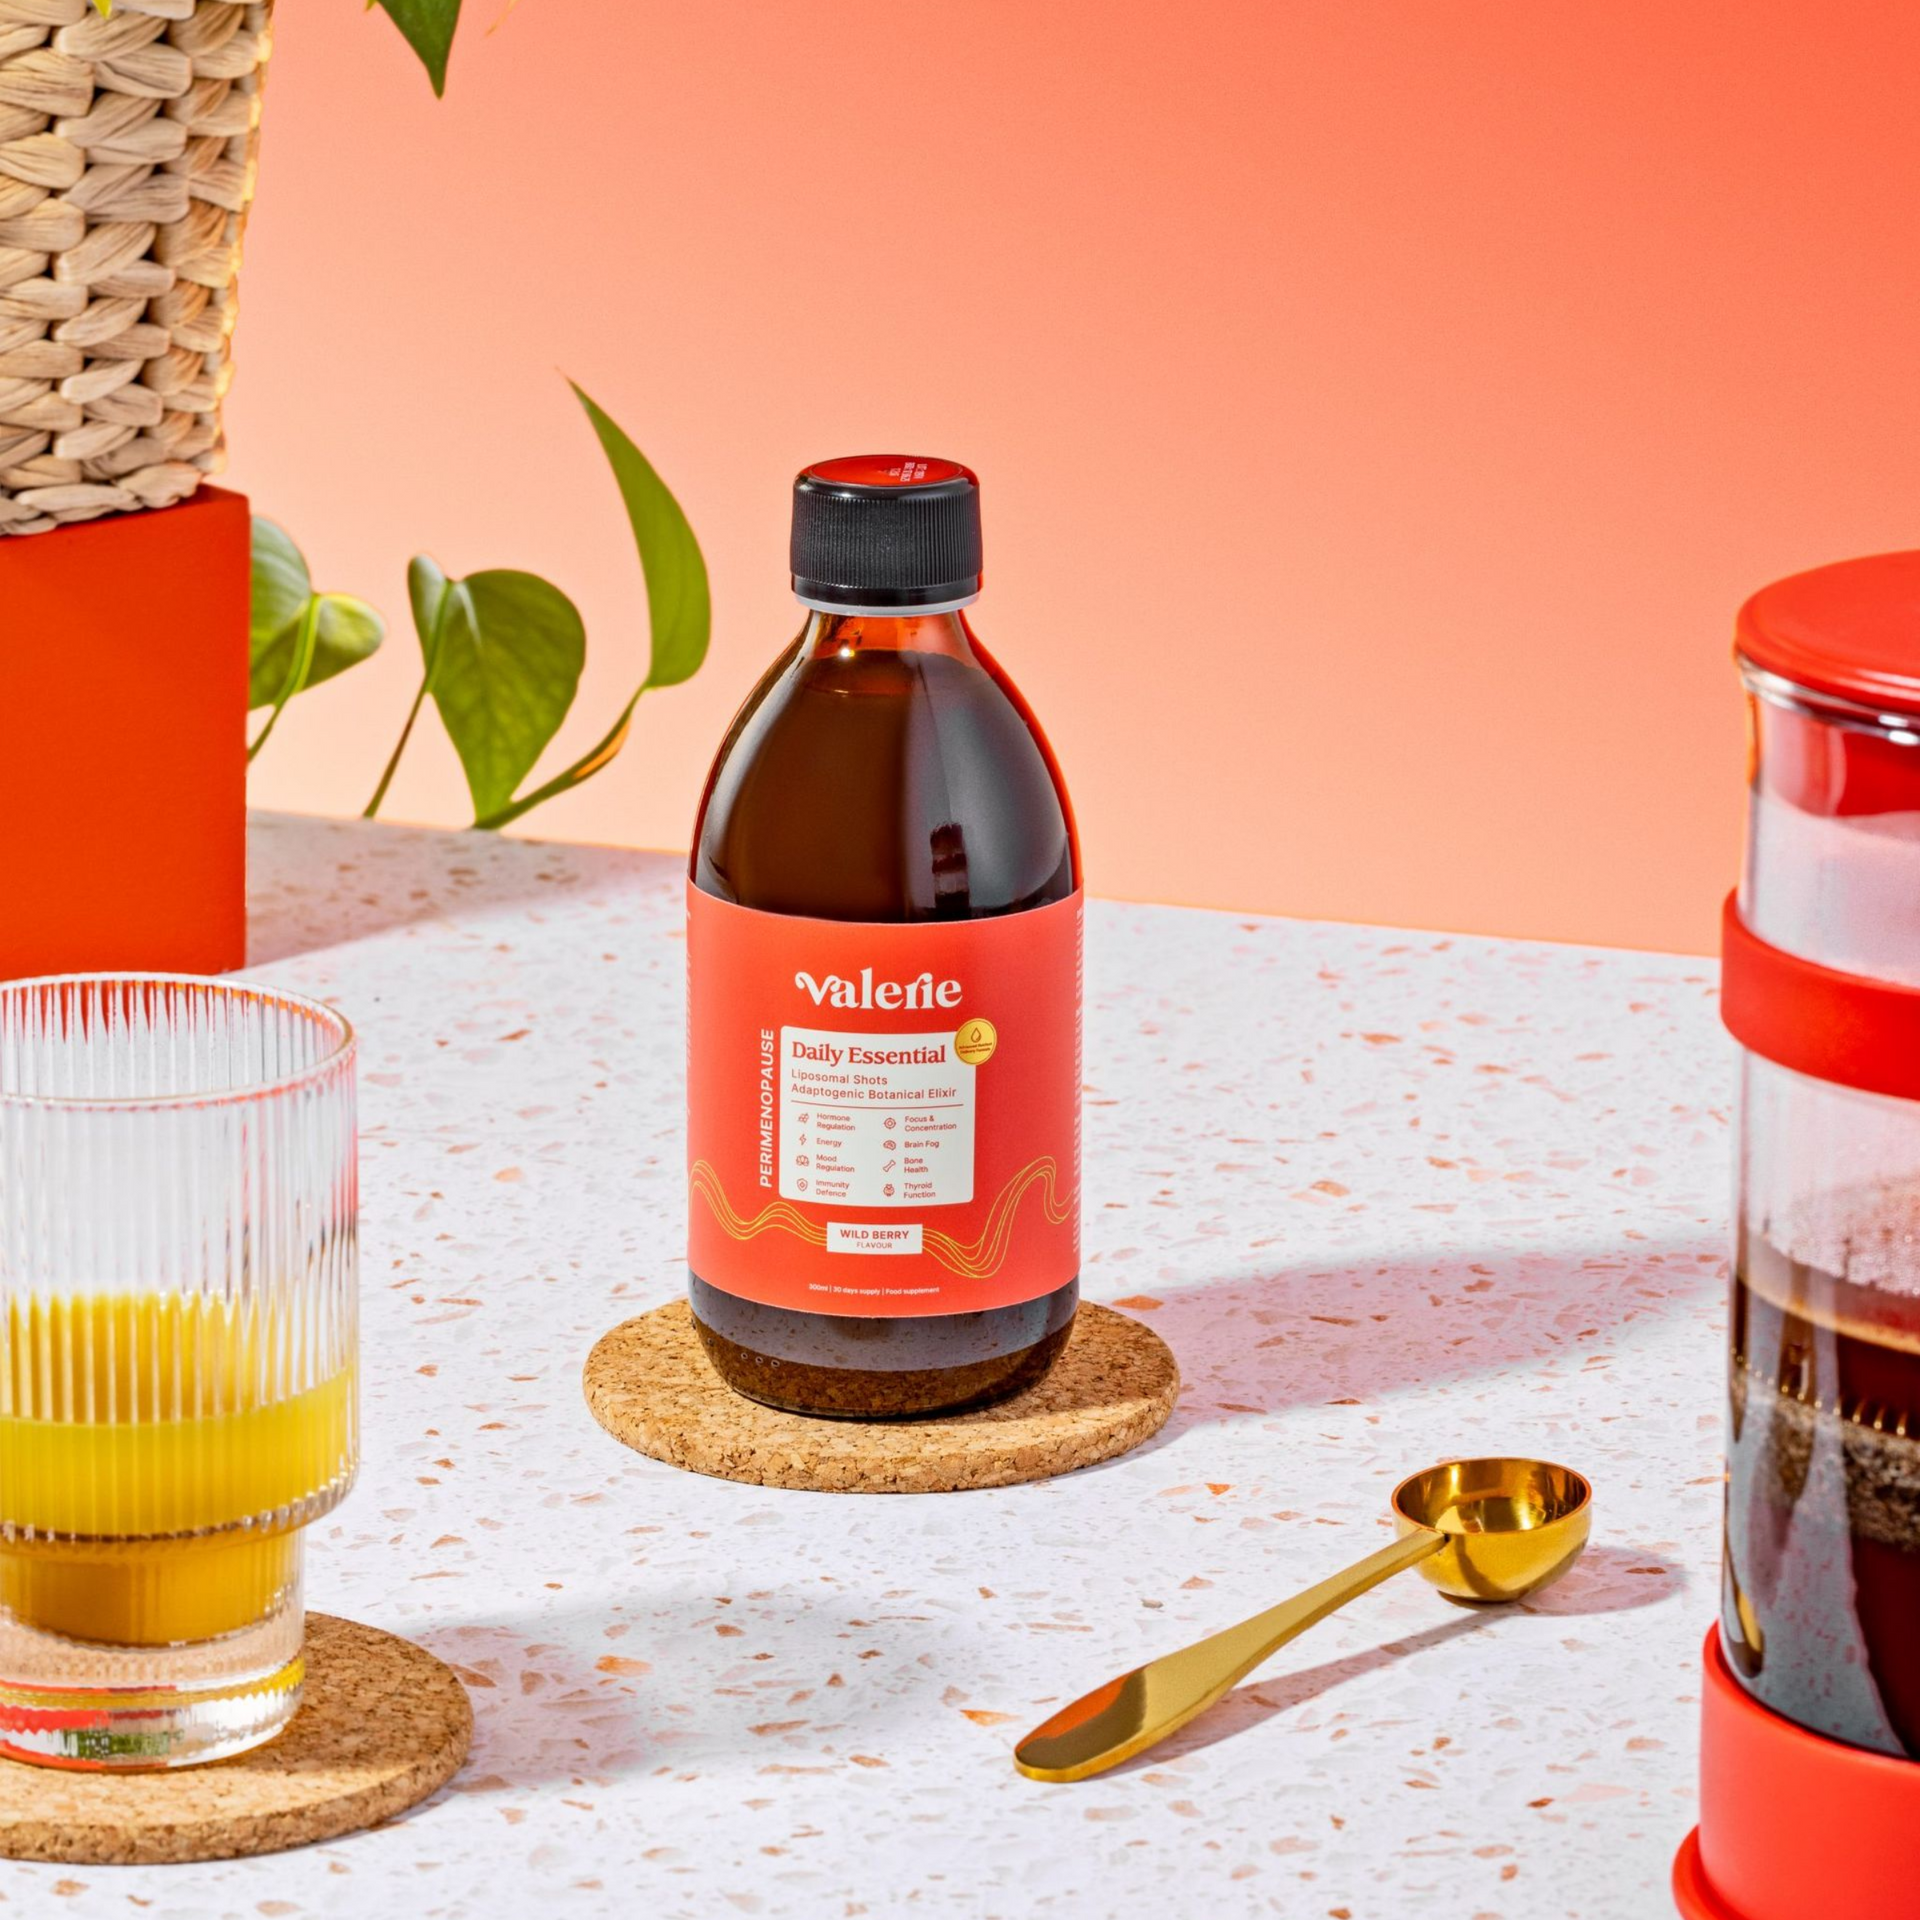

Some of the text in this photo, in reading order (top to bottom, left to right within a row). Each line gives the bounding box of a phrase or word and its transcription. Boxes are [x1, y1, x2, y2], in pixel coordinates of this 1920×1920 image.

[792, 1041, 946, 1067] Daily Essential
[791, 1068, 888, 1085] Liposomal Shots
[791, 1083, 956, 1100] Adaptogenic Botanical Elixir
[760, 1028, 774, 1188] PERIMENOPAUSE
[816, 1113, 850, 1122] Hormone
[904, 1115, 927, 1123] Focus
[816, 1122, 855, 1132] Regulation
[904, 1123, 957, 1132] Concentration
[816, 1138, 842, 1147] Energy
[926, 1140, 940, 1148] Fog
[816, 1154, 837, 1162] Mood
[816, 1163, 855, 1173] Regulation
[816, 1180, 850, 1189] Immunity
[904, 1182, 933, 1190] Thyroid
[816, 1188, 846, 1197] Defence
[904, 1191, 936, 1199] Function
[840, 1229, 909, 1240] WILD BERRY
[843, 1286, 858, 1294] days
[860, 1287, 880, 1296] supply
[903, 1286, 940, 1295] supplement
